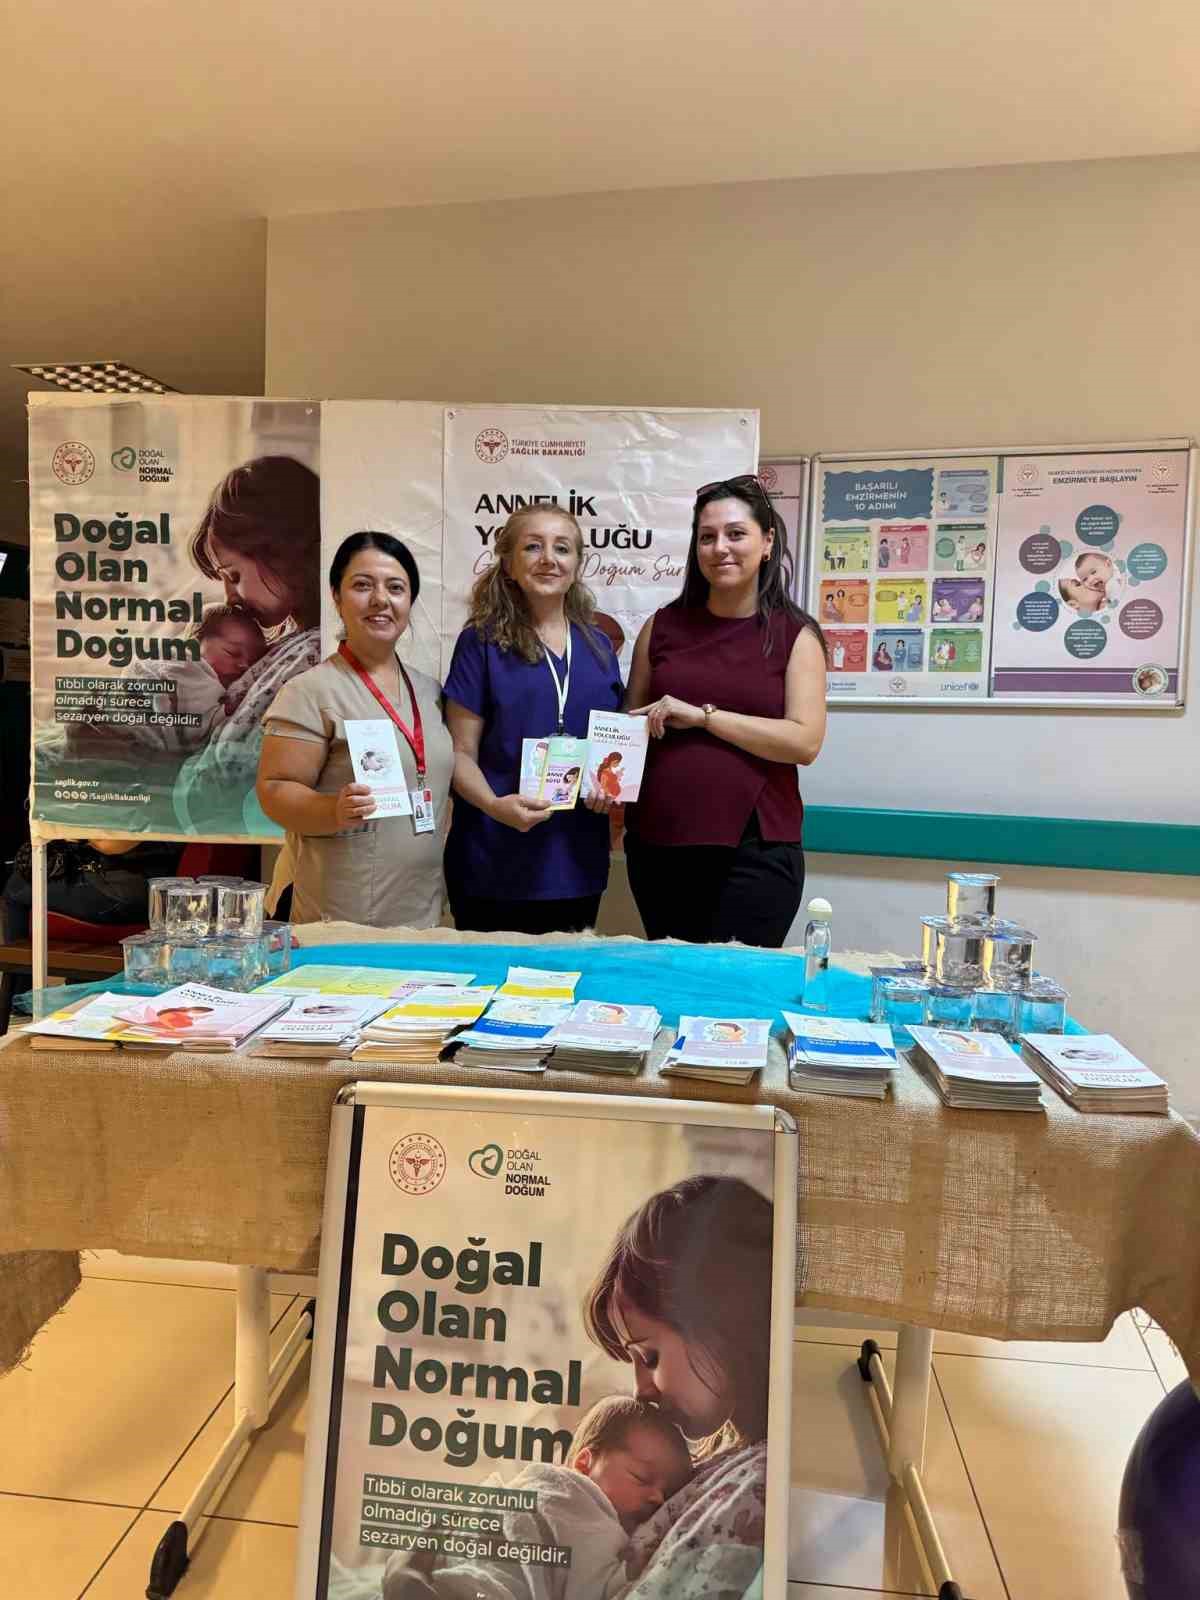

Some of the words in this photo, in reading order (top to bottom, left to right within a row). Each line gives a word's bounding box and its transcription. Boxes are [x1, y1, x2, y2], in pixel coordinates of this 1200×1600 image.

[139, 448, 165, 458] DOĞAL
[510, 447, 540, 456] SAĞLIK
[139, 466, 174, 475] NORMAL
[139, 474, 170, 483] DOĞUM
[54, 511, 171, 551] Doğal
[55, 550, 148, 582] Olan
[55, 591, 203, 623] Normal
[56, 628, 201, 667] Doğum
[87, 680, 124, 691] olarak
[127, 681, 175, 692] zorunlu
[56, 694, 107, 708] olmadığı
[56, 711, 109, 723] sezaryen
[112, 713, 146, 725] doğal
[150, 714, 200, 726] değildir.
[506, 1160, 534, 1171] OLAN
[507, 1148, 542, 1161] DOĞAL
[504, 1184, 545, 1197] DOĞUM
[505, 1173, 552, 1186] NORMAL
[380, 1232, 543, 1295] Doğal
[377, 1289, 507, 1343] Olan
[372, 1345, 583, 1407] Normal
[368, 1401, 575, 1468] Doğum
[365, 1477, 406, 1497] Tıbbi
[410, 1483, 463, 1502] olarak
[468, 1490, 534, 1510] zorunlu
[363, 1503, 437, 1528] olmadığı
[441, 1512, 500, 1532] sürece
[361, 1528, 438, 1550] sezaryen
[443, 1536, 492, 1558] doğal
[497, 1542, 568, 1565] değildir.
